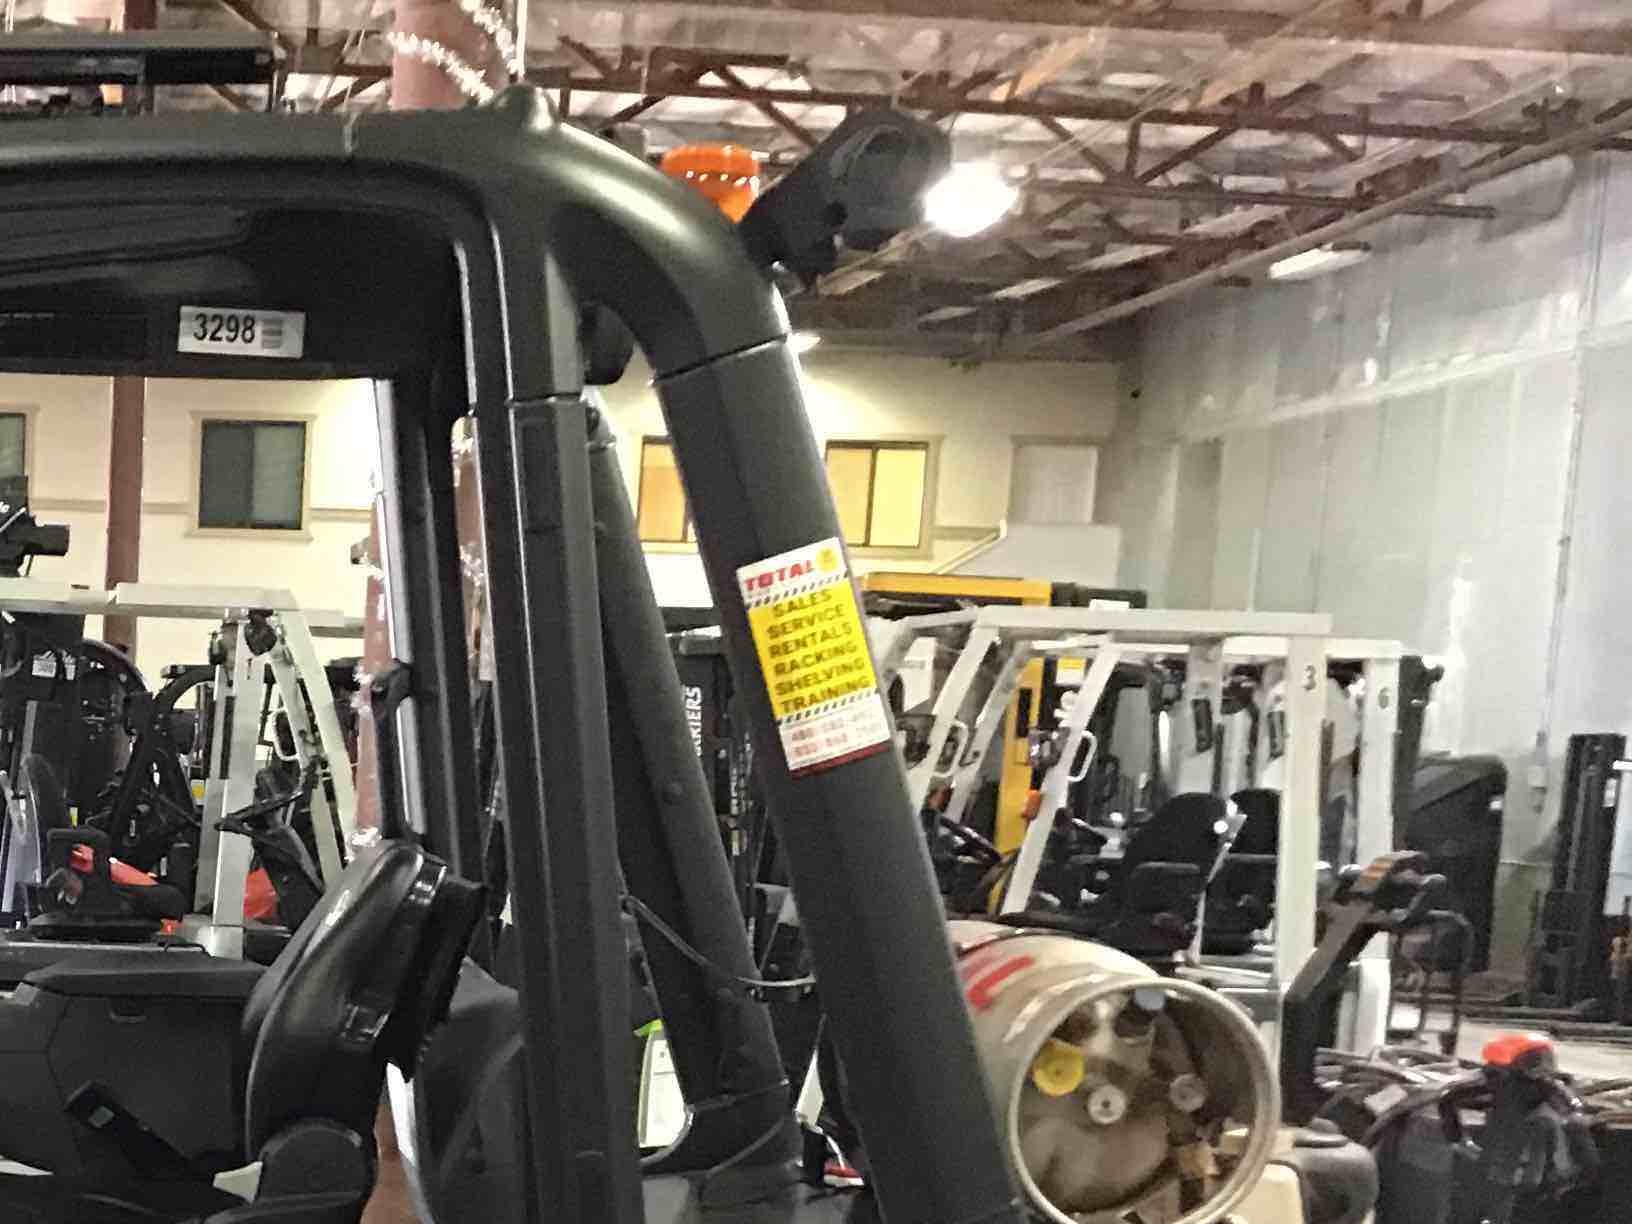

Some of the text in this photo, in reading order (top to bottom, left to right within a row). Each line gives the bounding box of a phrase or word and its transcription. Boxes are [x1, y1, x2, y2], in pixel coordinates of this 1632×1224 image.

[193, 313, 256, 344] 3298
[744, 560, 813, 591] TOTAL
[766, 604, 845, 640] SERVICE
[773, 589, 833, 619] SALES
[768, 623, 853, 660] RENTALS
[773, 640, 858, 677] RACKING
[774, 657, 866, 697] SHELVING
[779, 675, 871, 714] TRAINING
